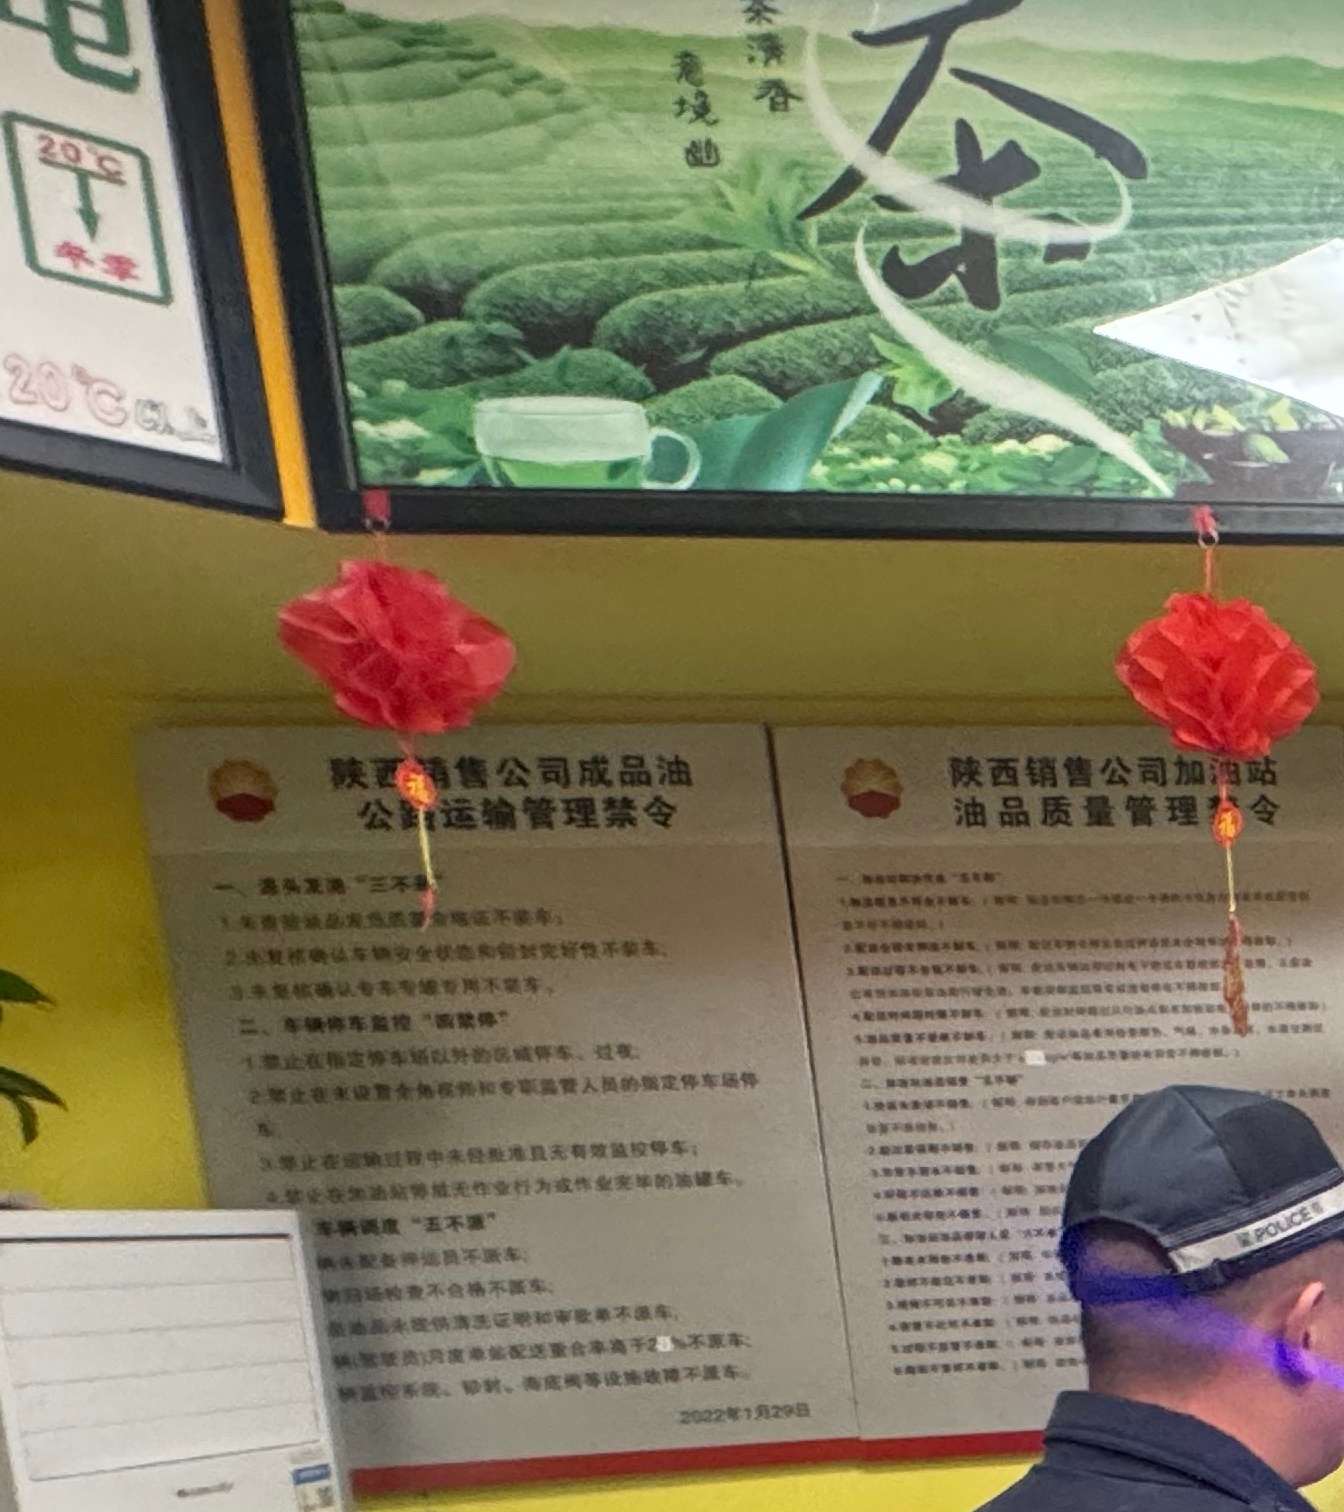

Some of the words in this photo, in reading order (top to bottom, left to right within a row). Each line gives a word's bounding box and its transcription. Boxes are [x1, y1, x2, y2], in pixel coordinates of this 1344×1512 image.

[949, 755, 1278, 788] 陕西销售公司加油站
[357, 796, 678, 831] 公路运输管理禁令
[955, 794, 1279, 828] 油品质量管理令
[1254, 1204, 1315, 1244] POLICE
